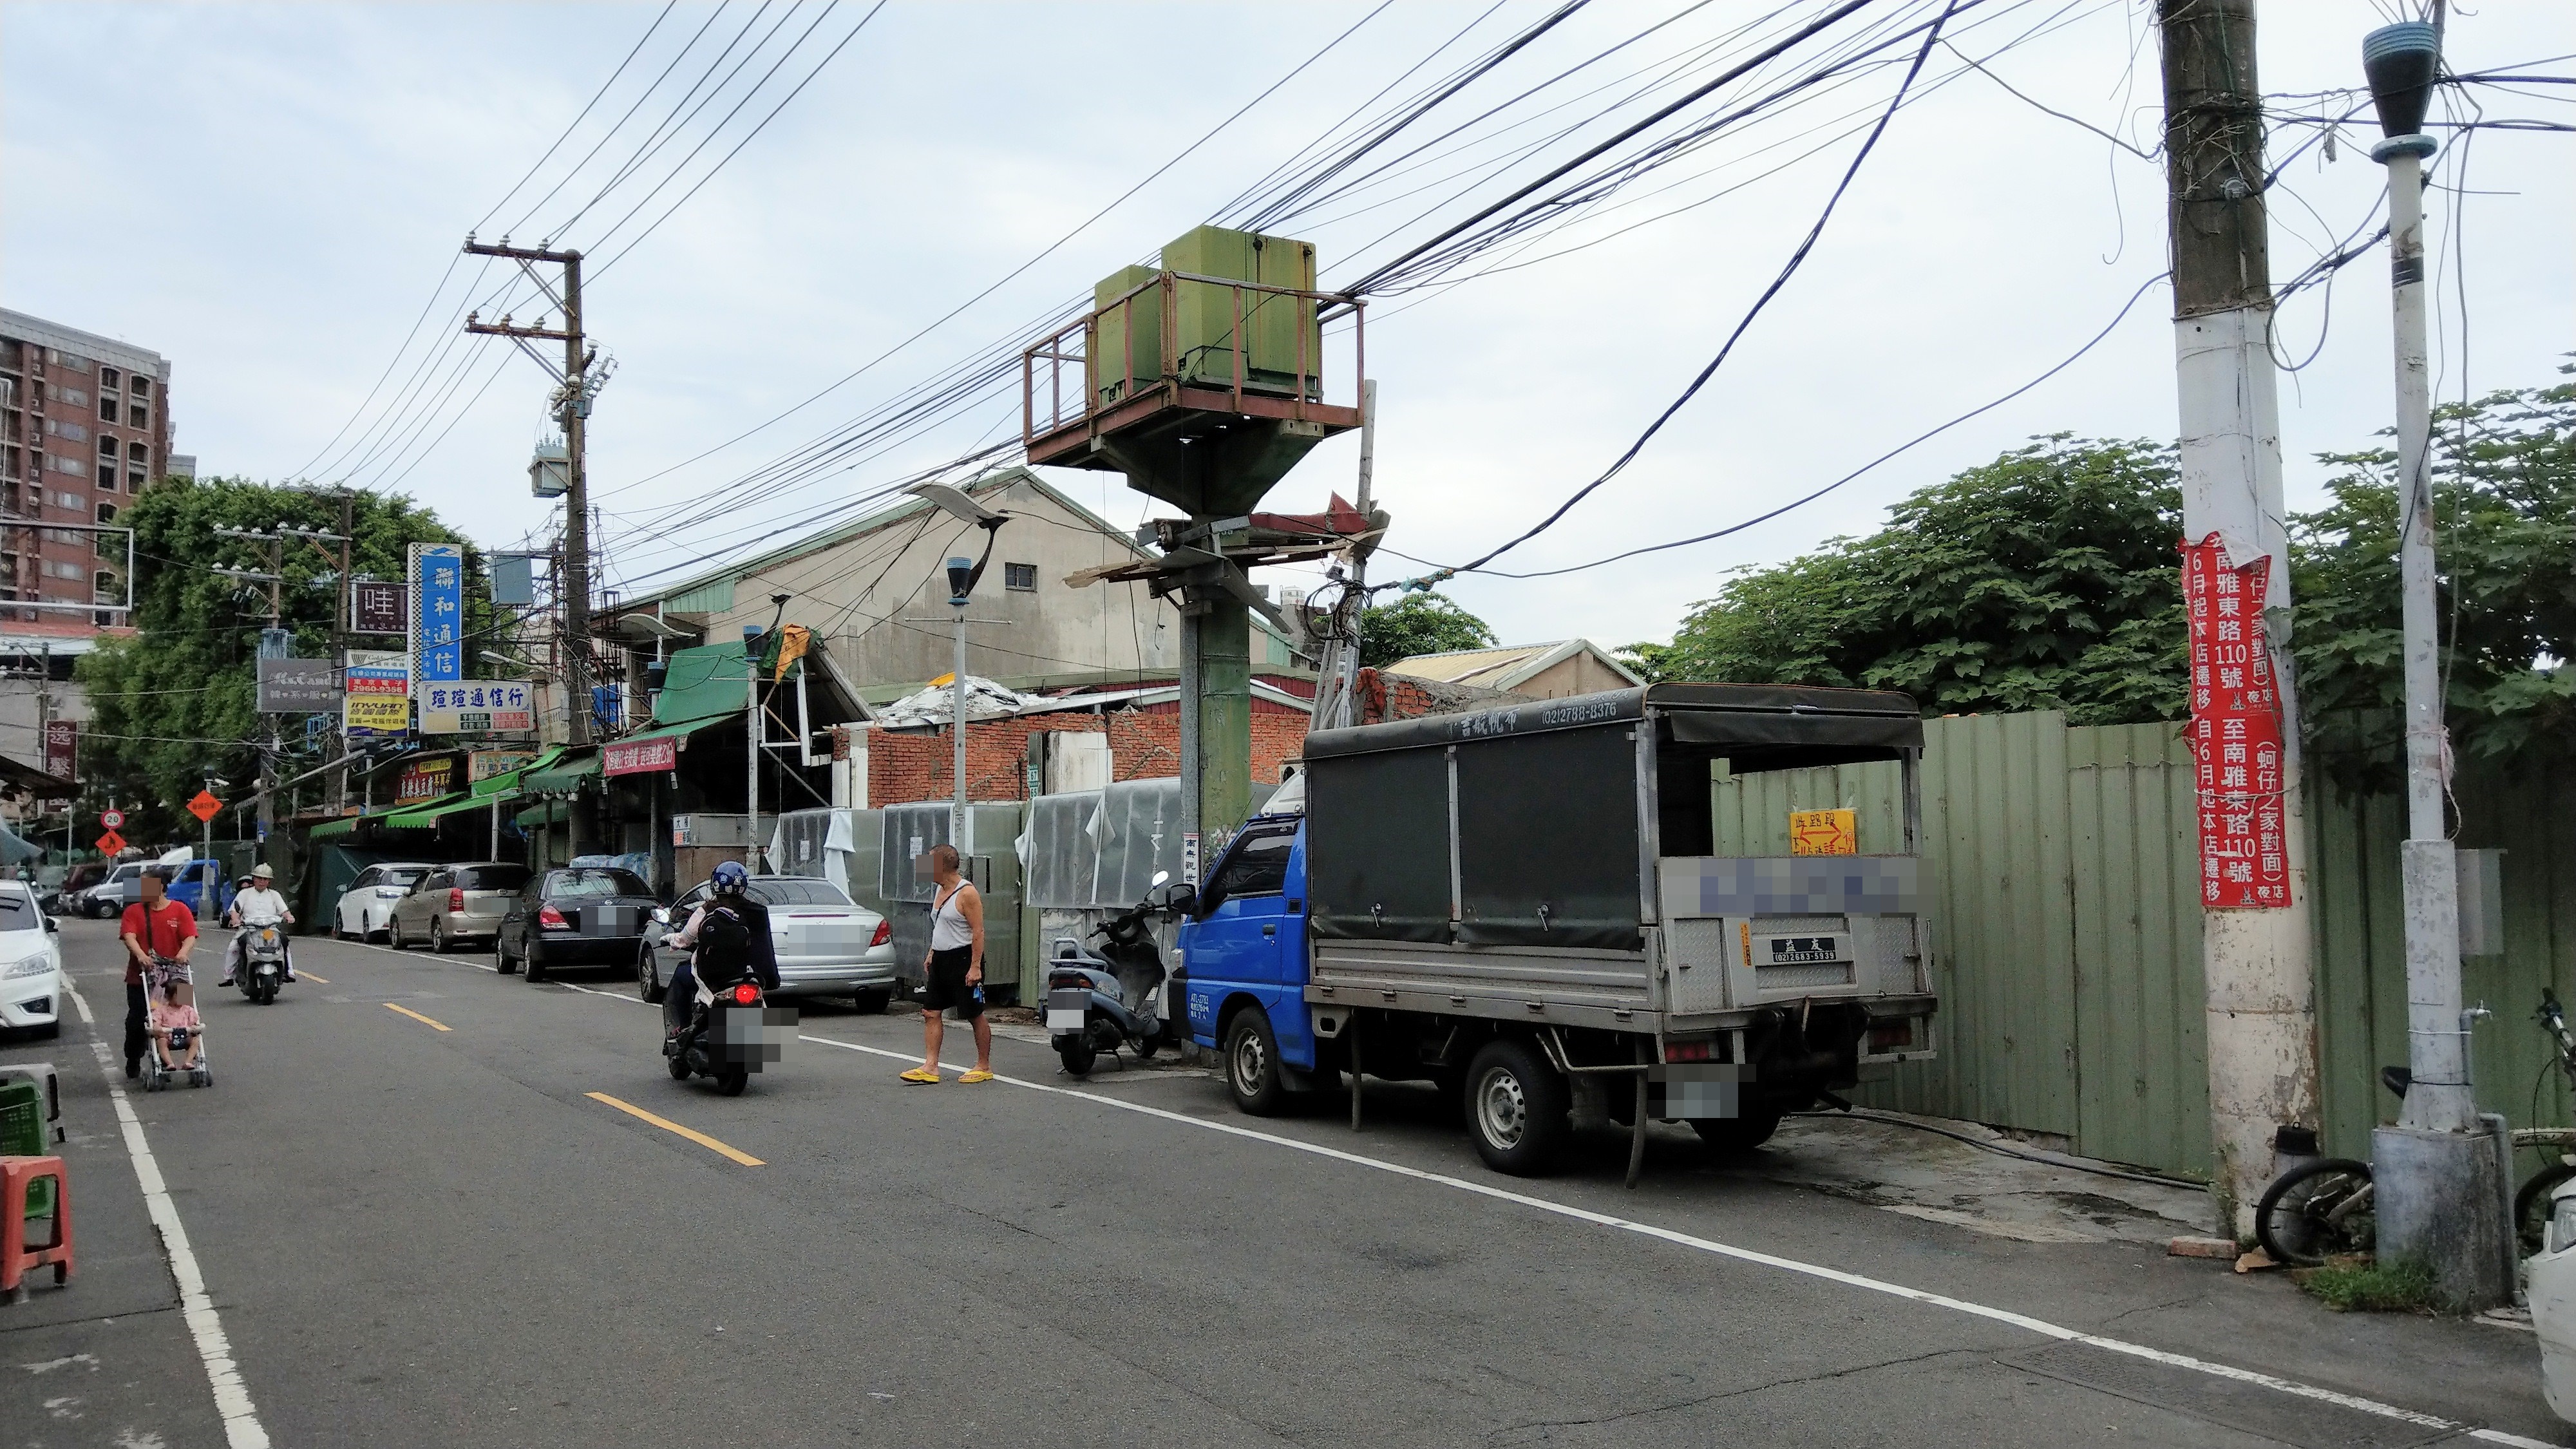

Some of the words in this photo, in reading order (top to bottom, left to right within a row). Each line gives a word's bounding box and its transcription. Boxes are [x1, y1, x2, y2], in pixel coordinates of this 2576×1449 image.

[365, 587, 394, 614] 哇
[435, 567, 455, 673] 聯和通信
[431, 688, 524, 708] 瑄瑄通信行
[1030, 772, 1037, 780] 67
[1030, 788, 1037, 797] 65
[2222, 718, 2255, 882] 至南雅東路110號
[2198, 719, 2220, 901] 自6月起本店遷移
[2257, 741, 2282, 882] (蚵仔之家對面)
[1186, 839, 1197, 882] 南無觀世
[2257, 885, 2284, 899] 夜店
[1775, 952, 1835, 961] (02)2683-5939
[1786, 938, 1823, 952] 益友
